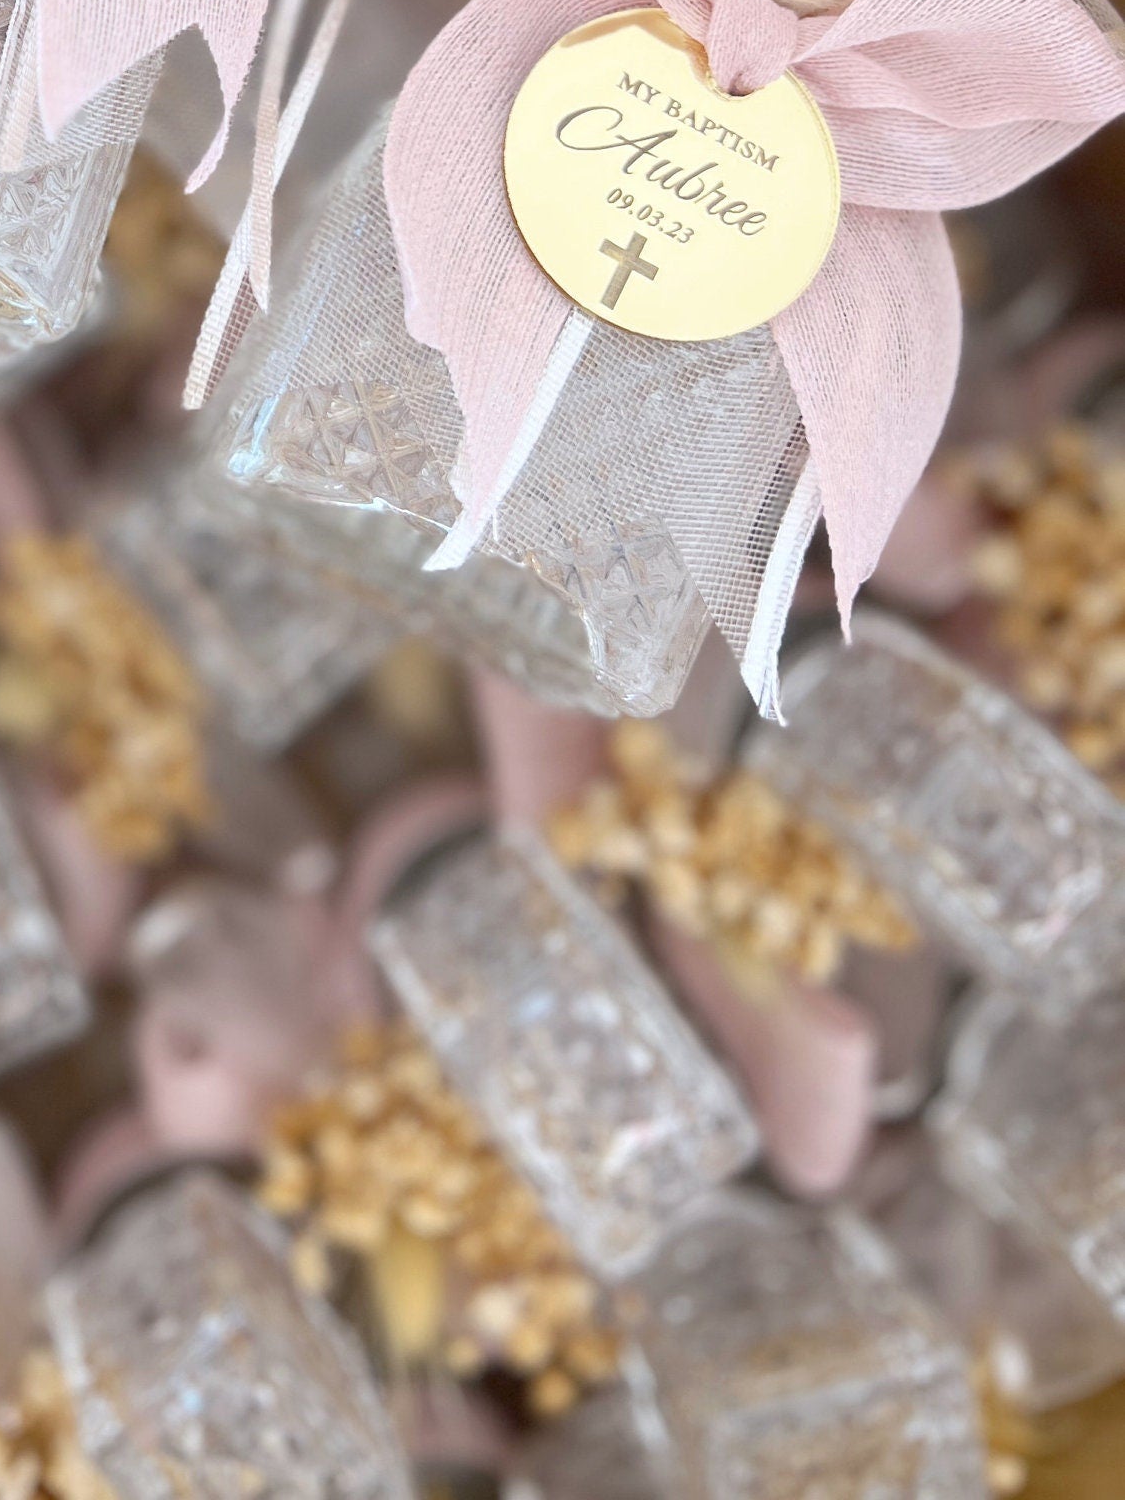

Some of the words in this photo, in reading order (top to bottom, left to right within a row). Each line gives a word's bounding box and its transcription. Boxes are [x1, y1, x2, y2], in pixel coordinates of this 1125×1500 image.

[556, 106, 767, 236] Aubree
[616, 72, 661, 105] MY
[663, 99, 779, 171] BAPTISM
[606, 188, 694, 244] 09.03.23
